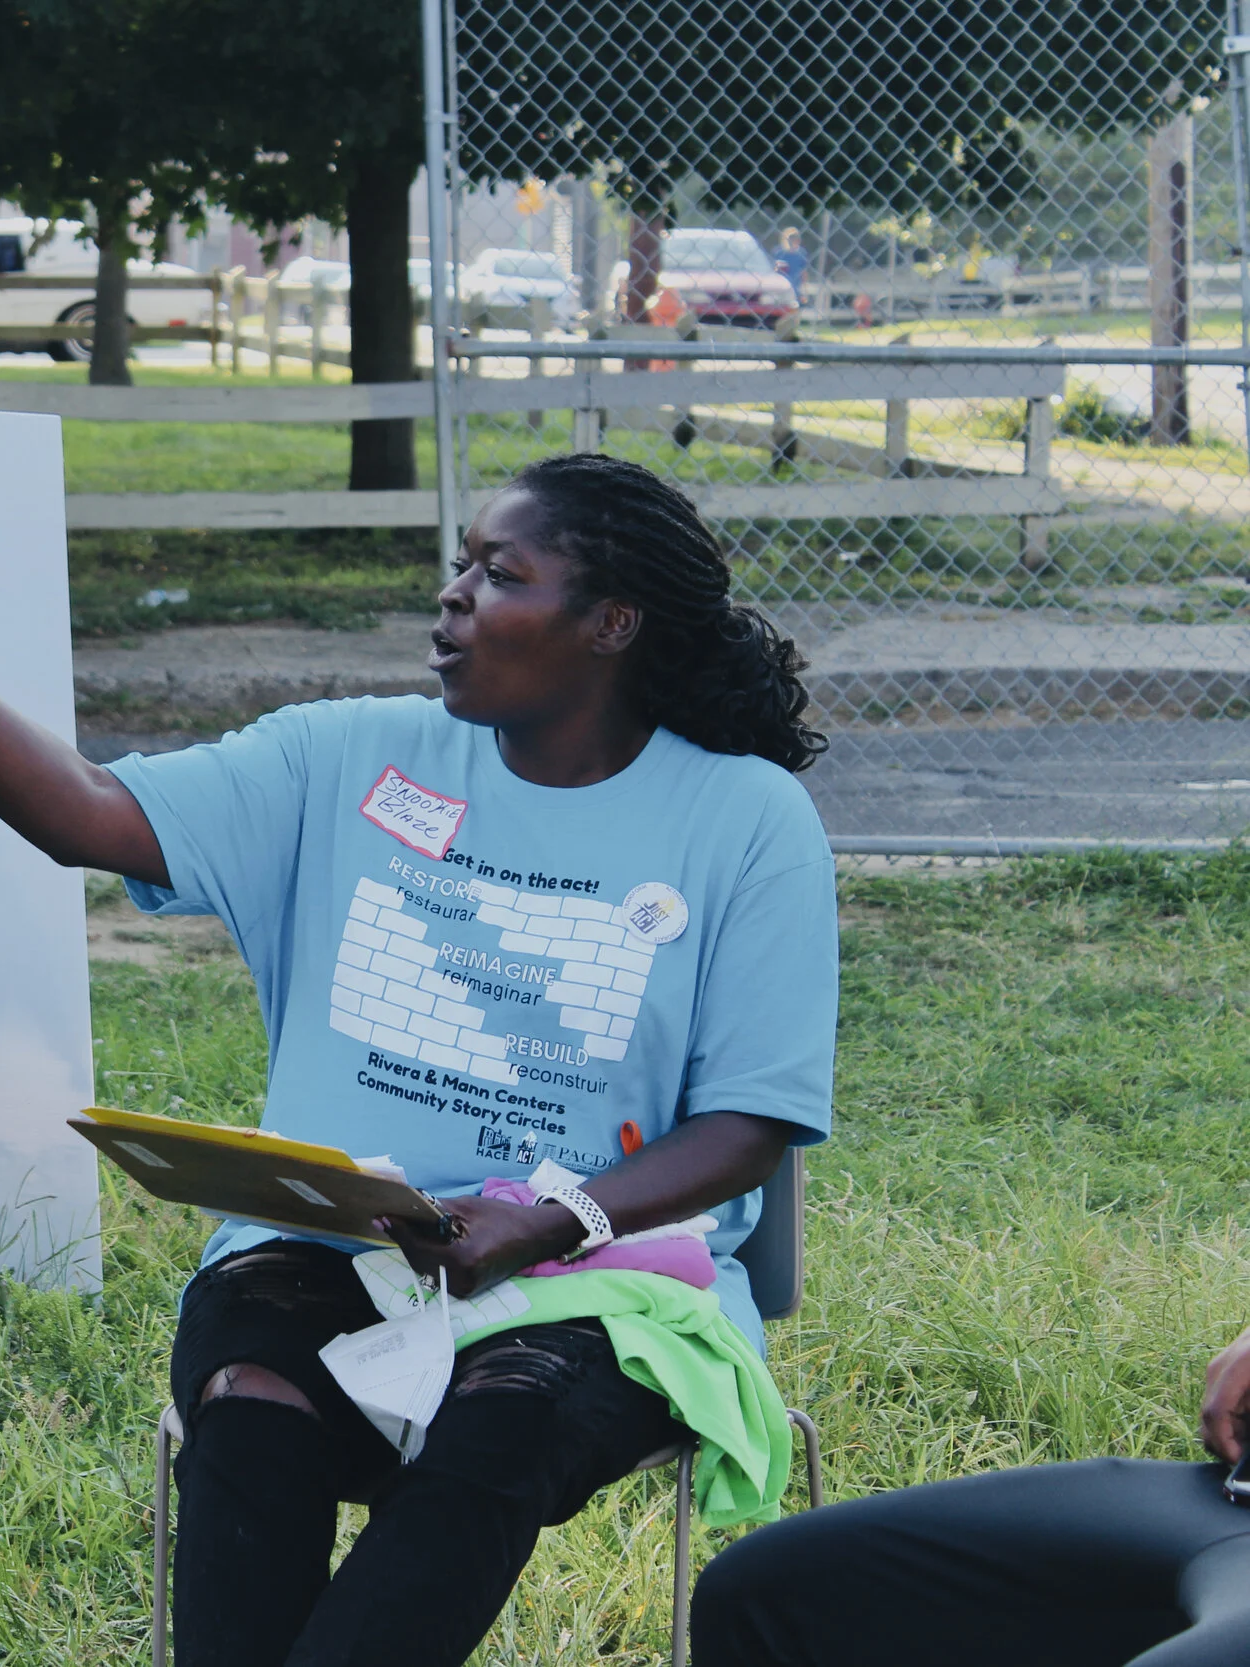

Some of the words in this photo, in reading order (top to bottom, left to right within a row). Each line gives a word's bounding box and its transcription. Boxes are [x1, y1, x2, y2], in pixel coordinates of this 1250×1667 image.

[388, 855, 483, 903] RESTORE
[443, 848, 474, 869] Get
[477, 860, 495, 877] in
[500, 869, 522, 885] on
[528, 872, 557, 889] the
[560, 877, 600, 894] act!
[396, 885, 477, 922] restaurar
[630, 908, 658, 935] ACT
[439, 941, 558, 987] REIMAGINE
[442, 968, 542, 1006] reimaginar
[505, 1033, 590, 1067] REBUILD
[367, 1051, 421, 1080] Rivera
[424, 1069, 438, 1085] &
[441, 1074, 490, 1100] Mann
[494, 1089, 566, 1115] Centers
[508, 1062, 608, 1094] reconstruir
[357, 1071, 448, 1113] Community
[451, 1098, 502, 1125] Story
[505, 1111, 567, 1136] Circles
[476, 1147, 510, 1161] HACE
[516, 1149, 536, 1164] ACT
